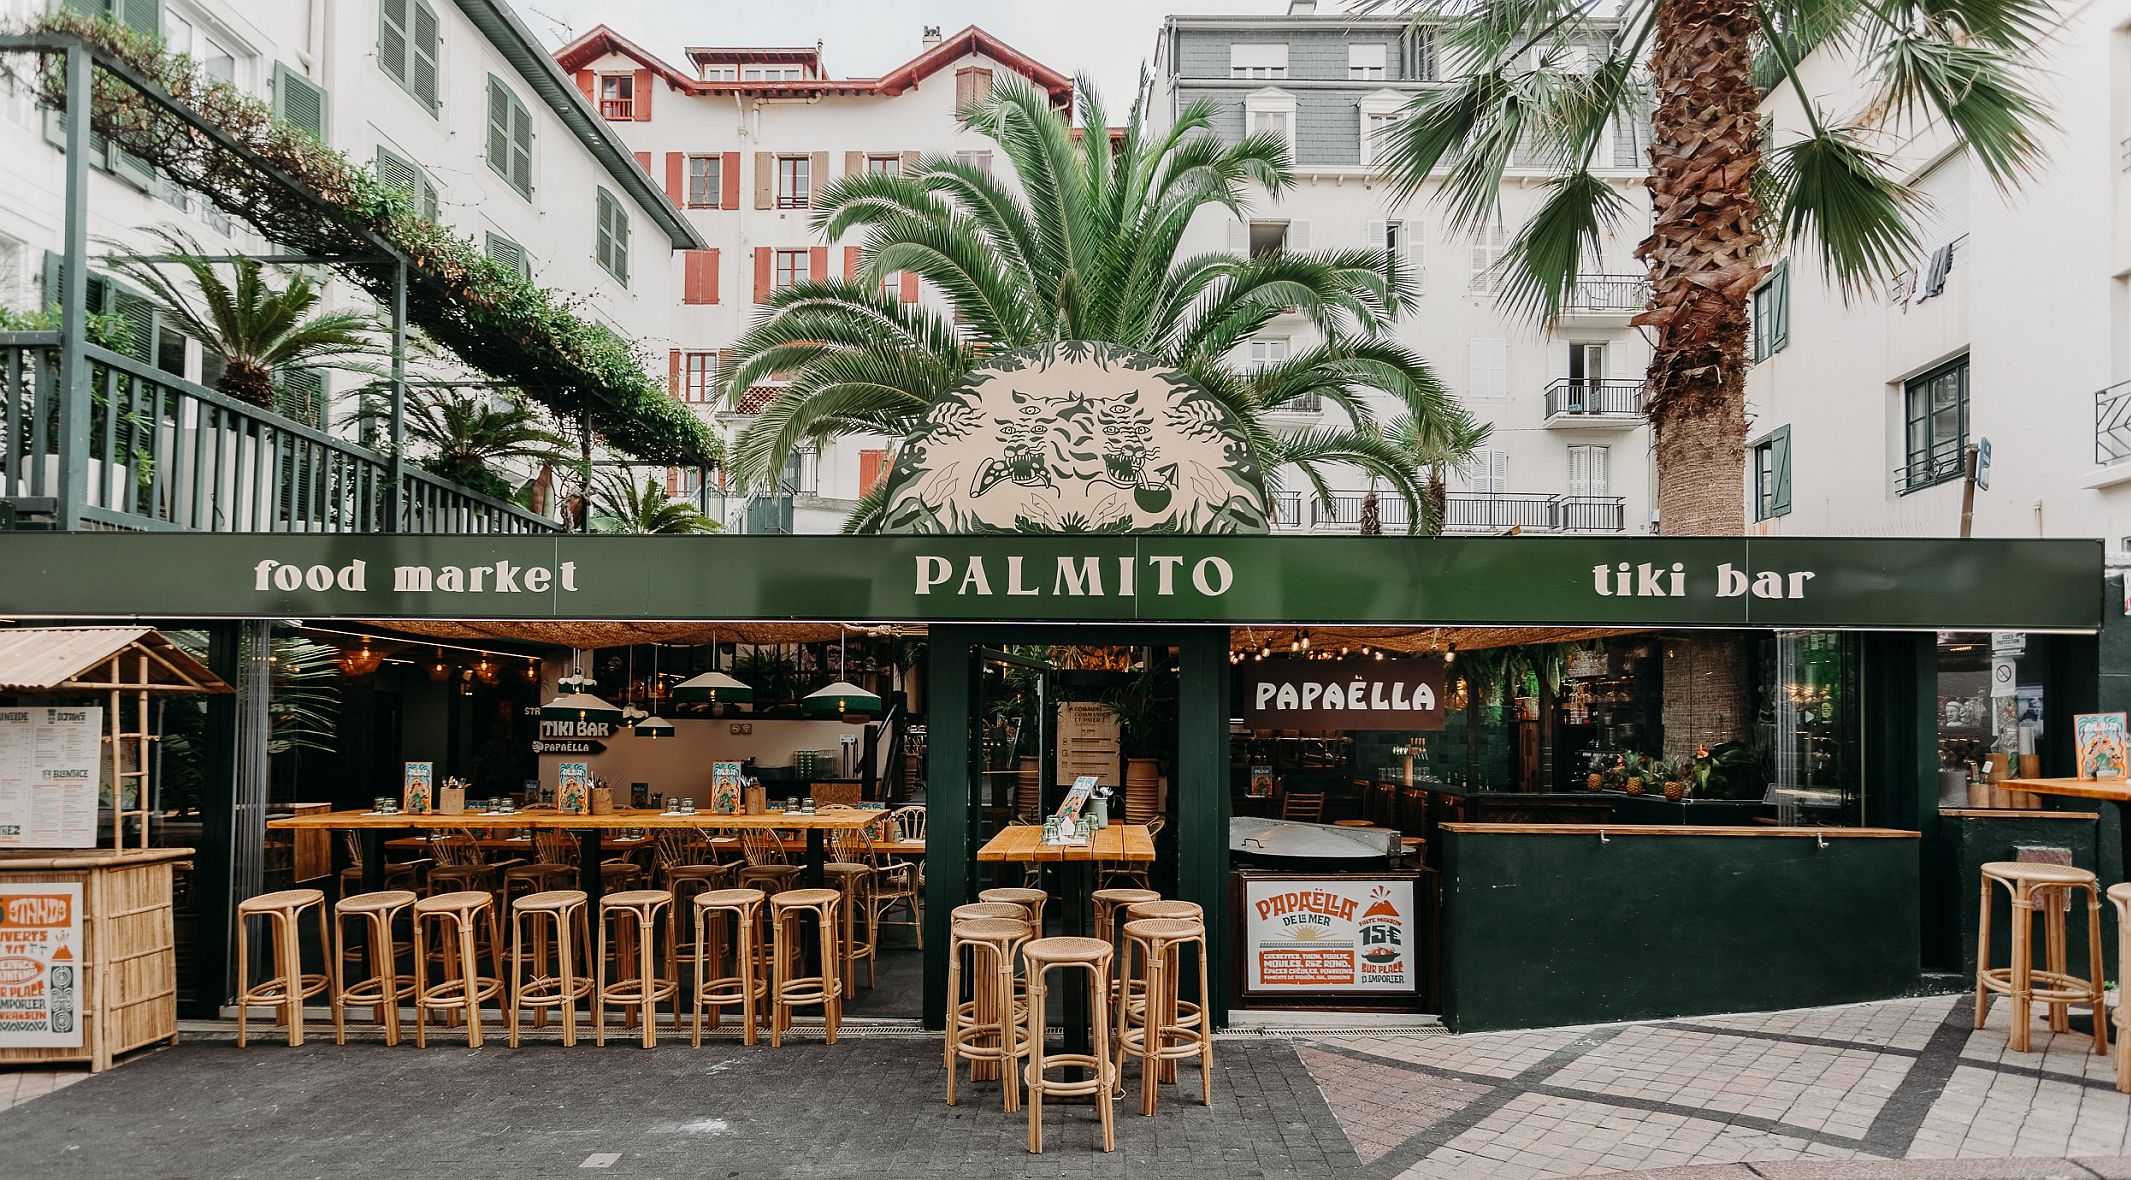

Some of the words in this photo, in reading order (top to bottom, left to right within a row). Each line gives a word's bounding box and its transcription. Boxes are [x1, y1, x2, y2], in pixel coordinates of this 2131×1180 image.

[255, 559, 366, 592] food
[394, 560, 578, 592] market
[915, 556, 1234, 597] PALMITO
[1592, 562, 1686, 597] tiki
[1715, 562, 1816, 599] bar
[1256, 675, 1436, 711] PAPAËLLA
[543, 721, 574, 737] TIKI
[577, 721, 609, 737] BAR
[544, 741, 590, 752] PAPAËLLA
[9, 897, 67, 925] STANDS
[1255, 888, 1359, 923] PAPAËLLA
[1283, 915, 1298, 926] DE
[1308, 914, 1331, 926] MER
[1359, 925, 1402, 946] 15€
[1361, 963, 1377, 974] SUR
[1378, 961, 1404, 974] PLACE
[10, 980, 45, 998] PLACE
[1368, 975, 1405, 984] EMPORTER
